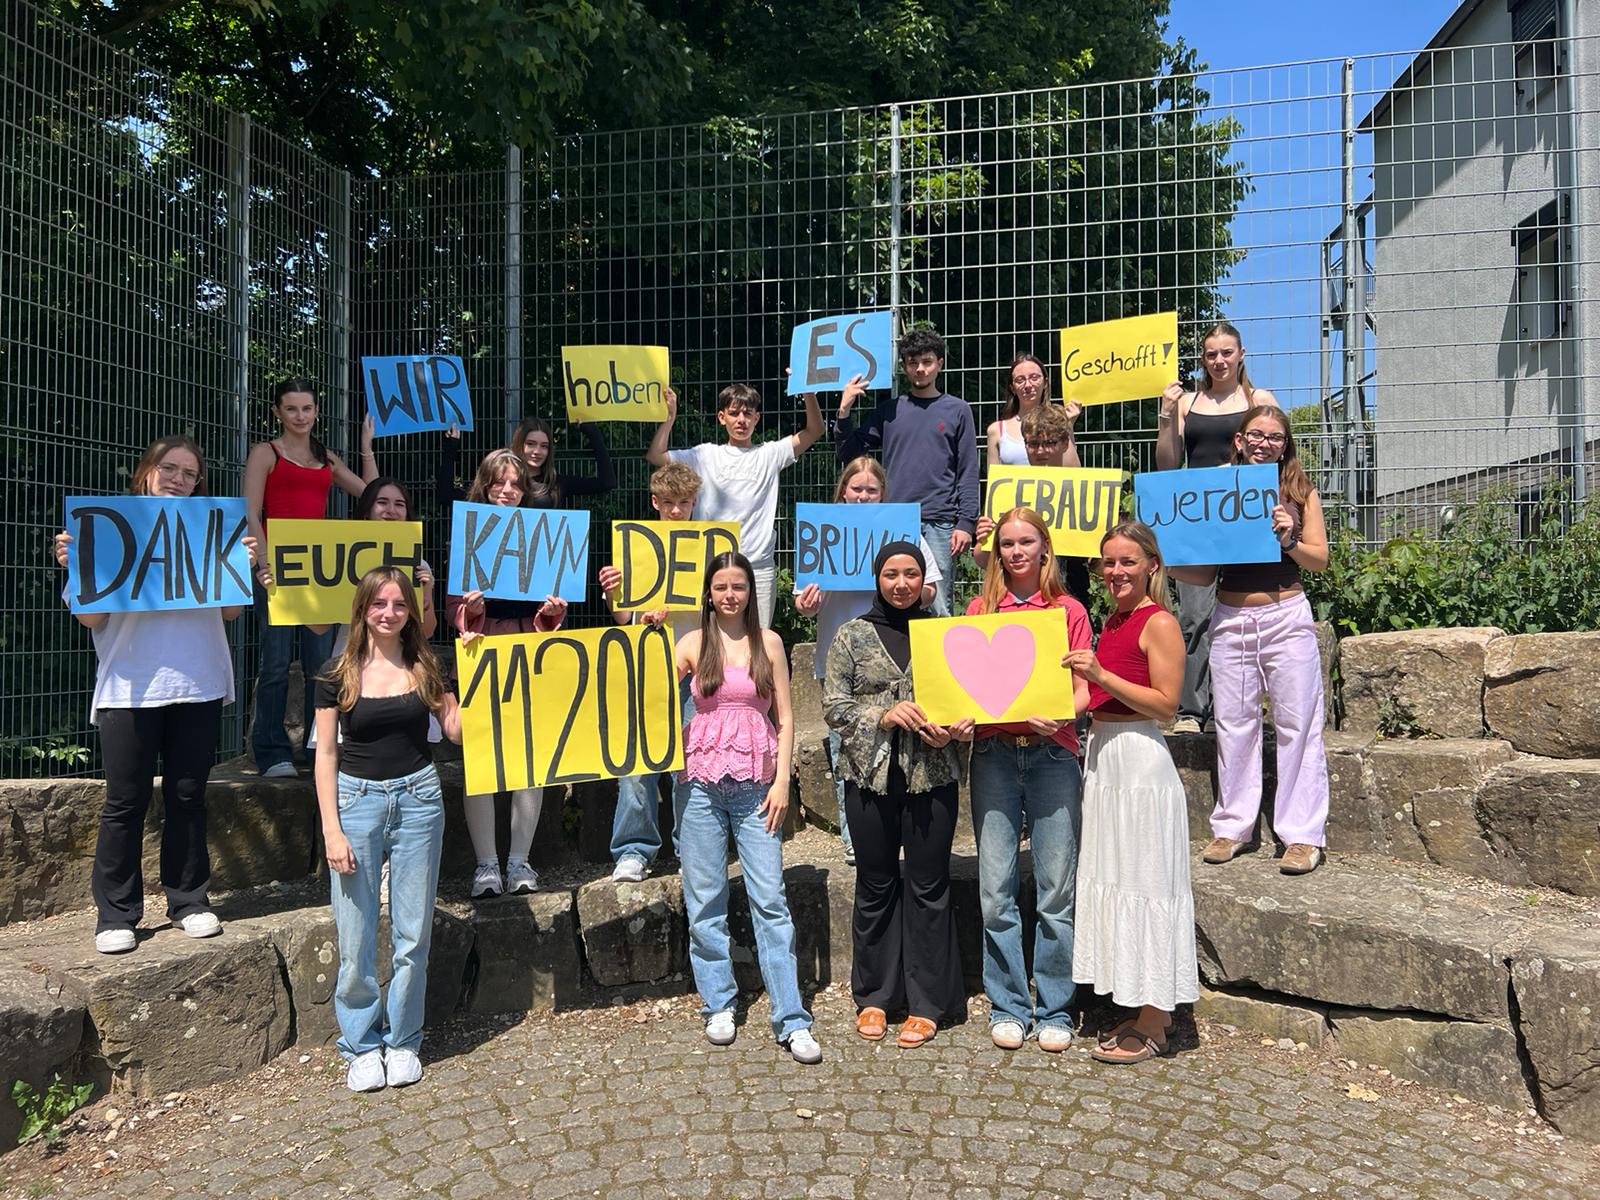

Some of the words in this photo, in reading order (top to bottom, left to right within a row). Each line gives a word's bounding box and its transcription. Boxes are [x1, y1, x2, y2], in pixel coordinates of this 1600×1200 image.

[806, 318, 877, 385] ES
[1064, 342, 1174, 382] Geschafft!
[369, 356, 465, 426] WIR
[564, 360, 661, 407] haben
[1137, 469, 1278, 527] werden
[71, 506, 251, 605] DANK
[275, 541, 421, 587] EUCH
[462, 509, 590, 597] KANN
